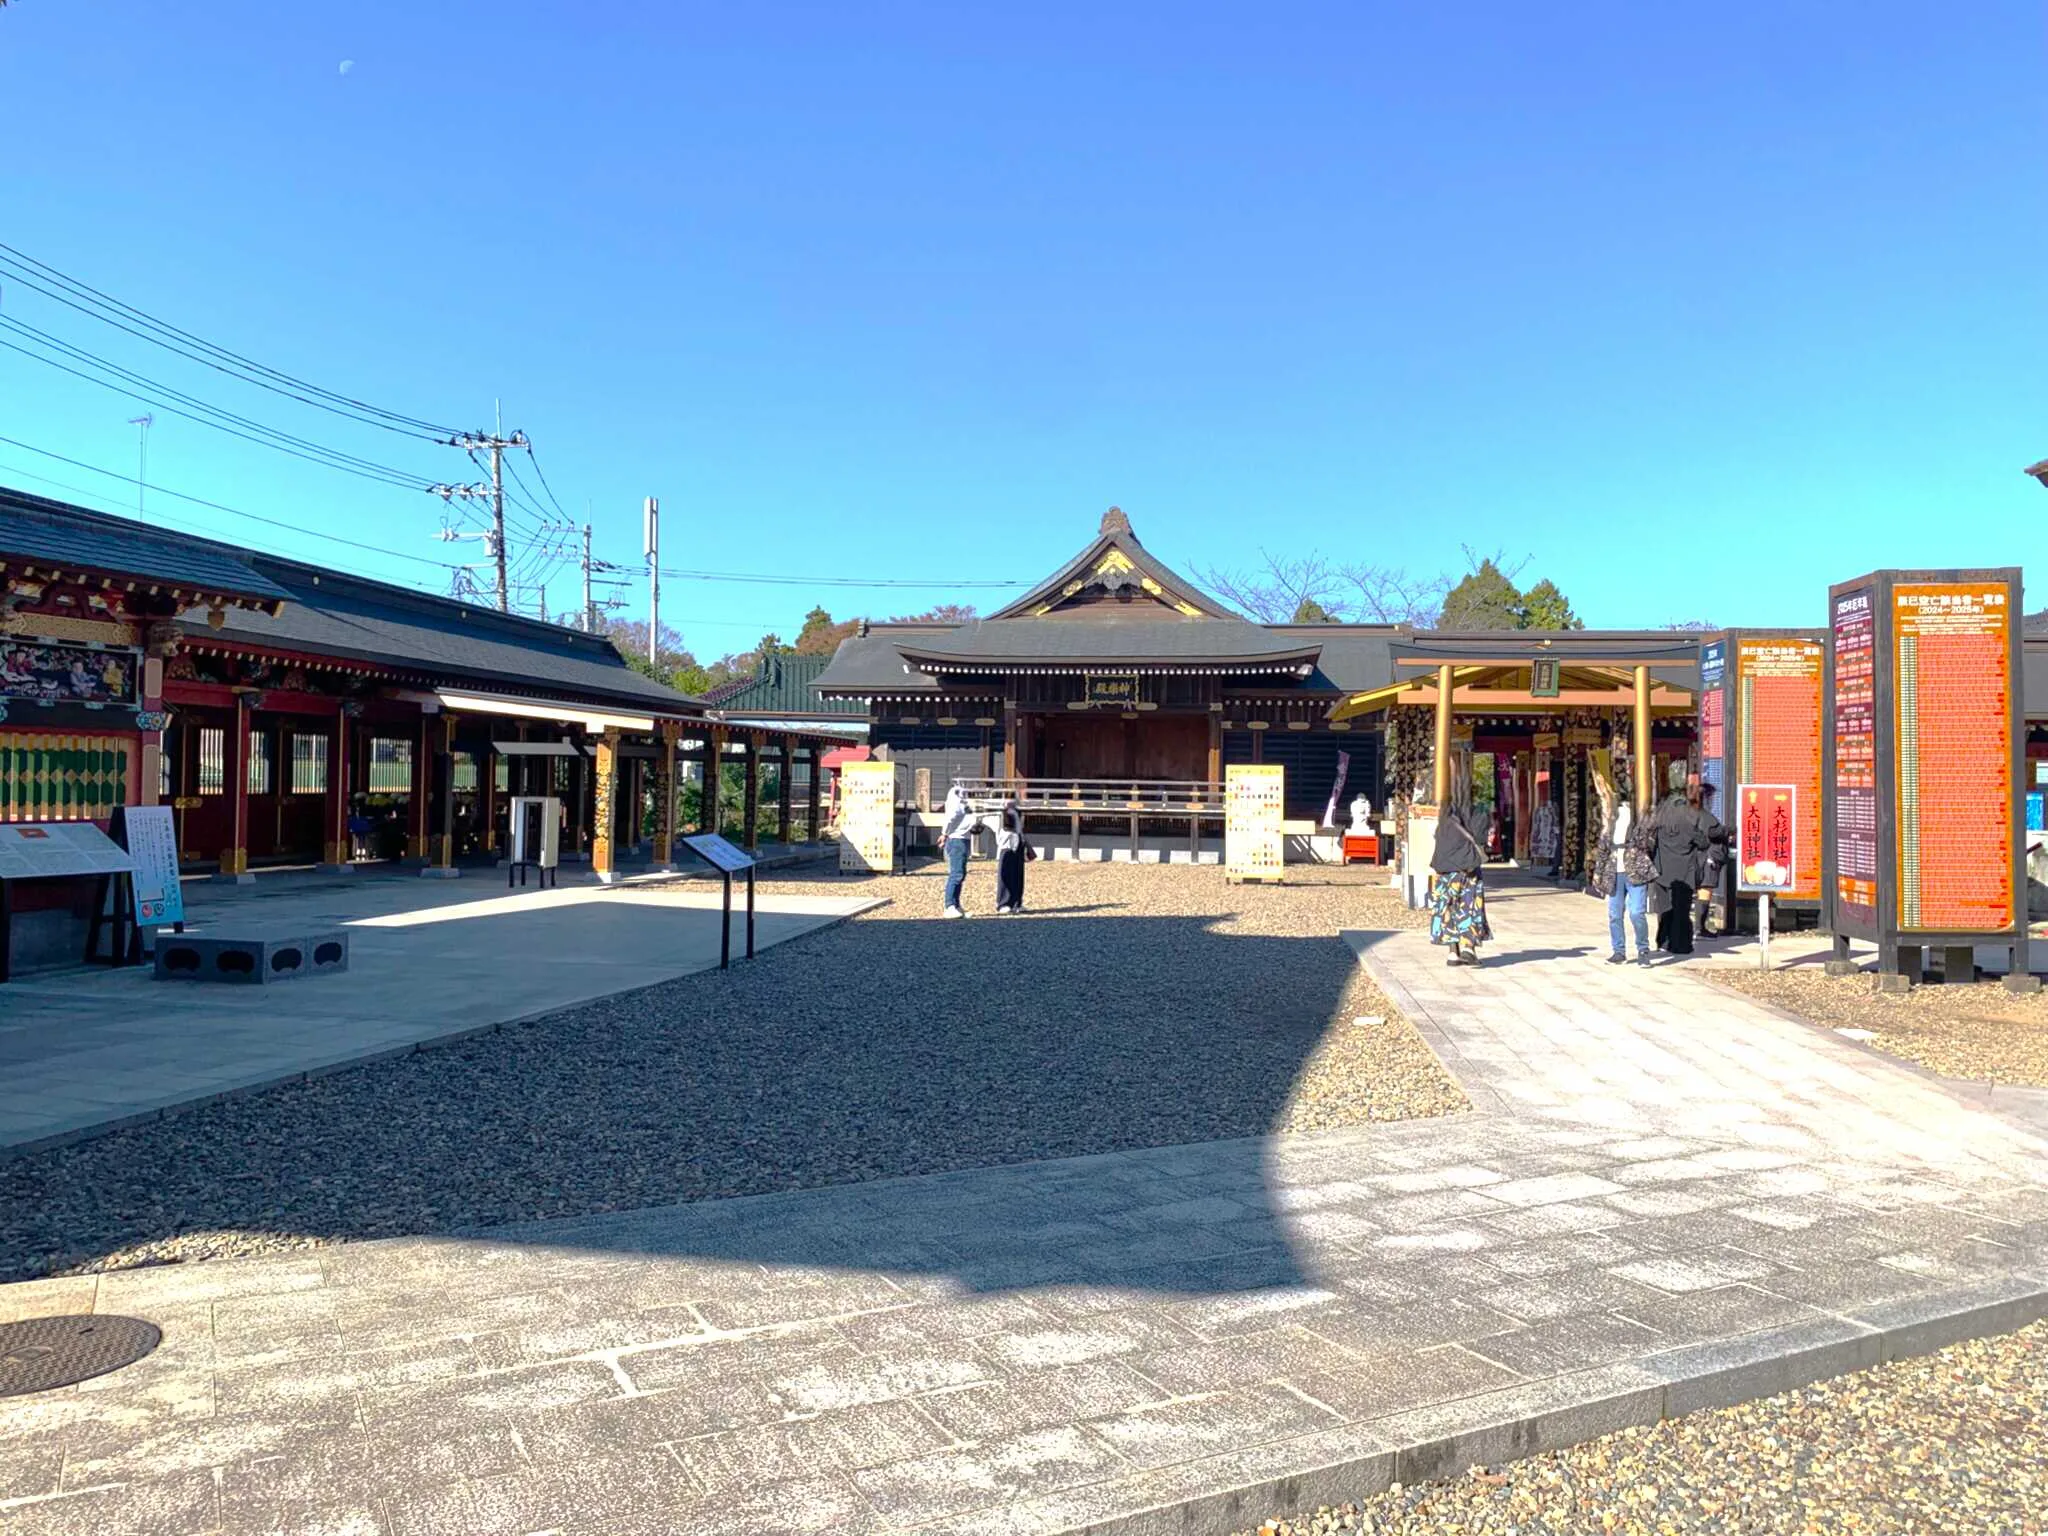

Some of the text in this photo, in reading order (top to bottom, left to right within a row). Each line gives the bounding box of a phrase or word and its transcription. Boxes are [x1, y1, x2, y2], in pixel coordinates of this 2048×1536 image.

[1746, 805, 1761, 860] 大国神社
[1773, 805, 1788, 860] 大杉神社
